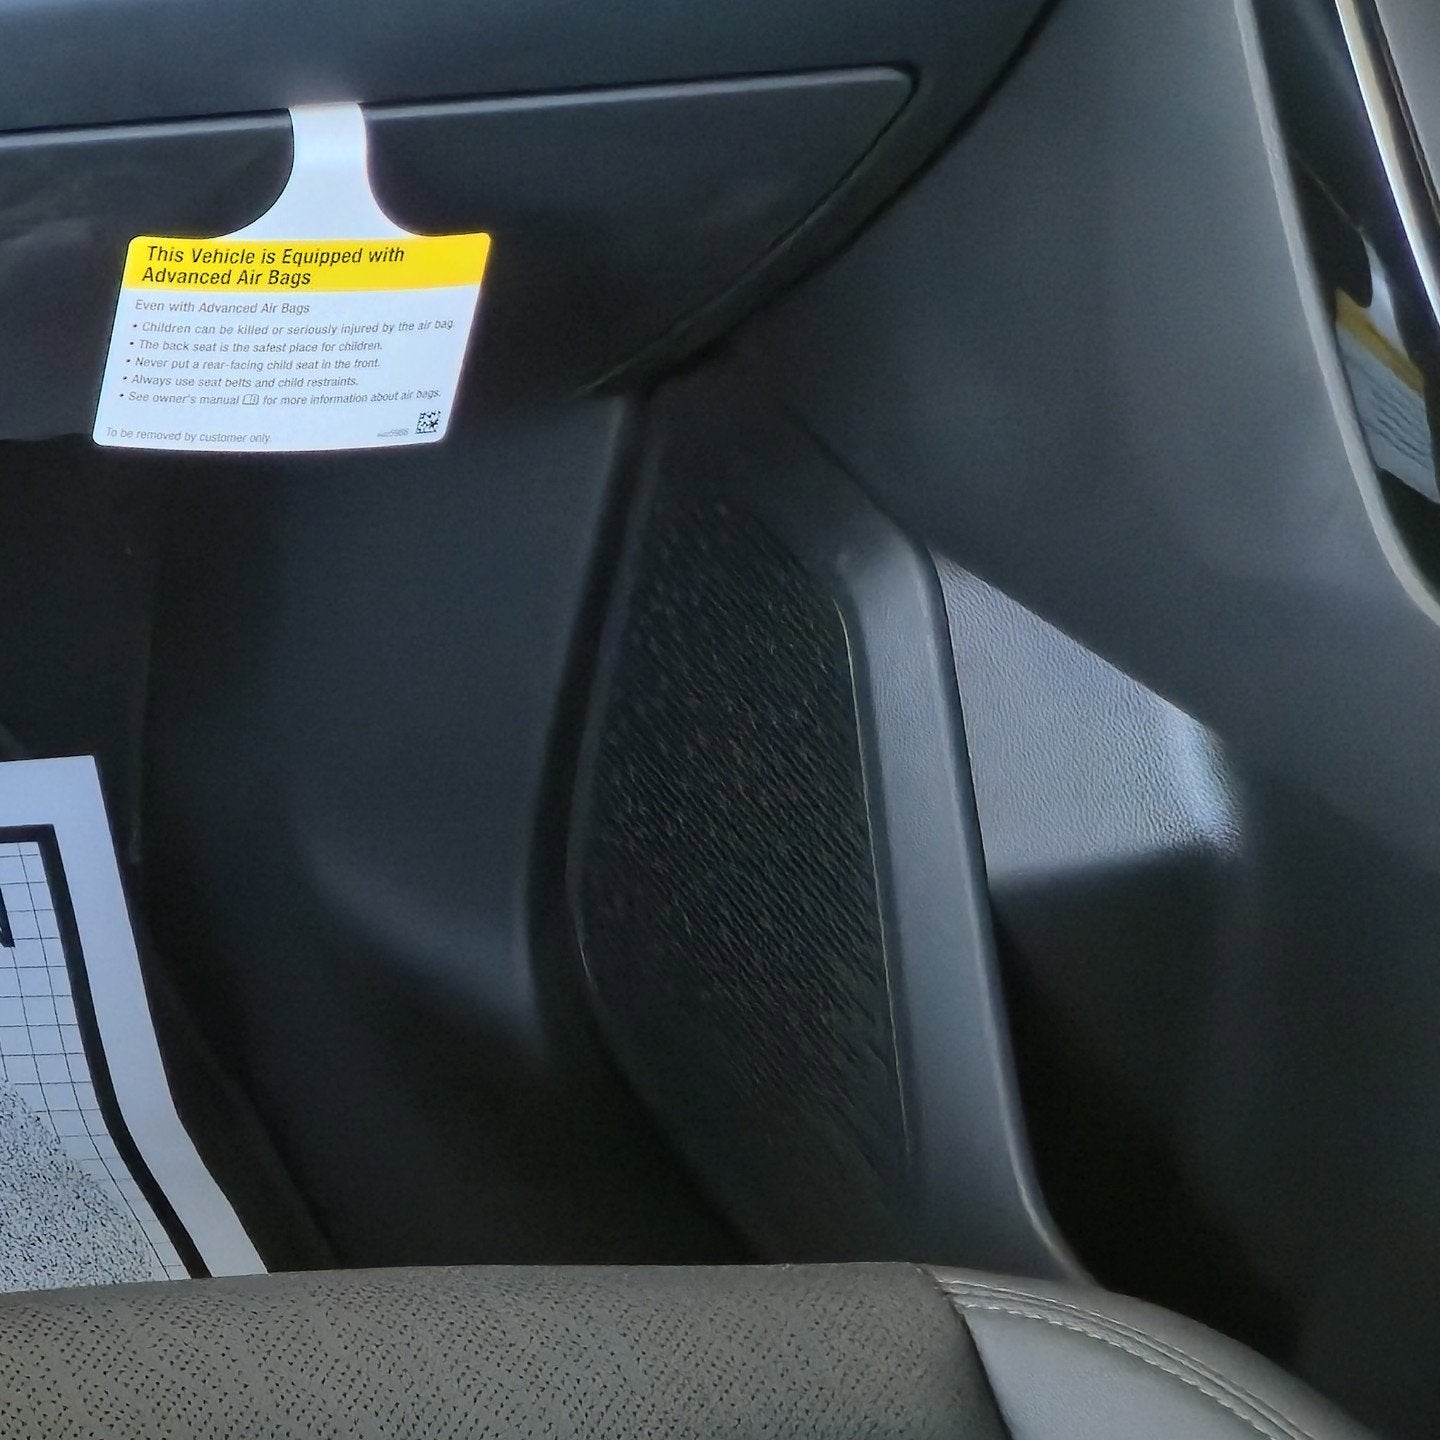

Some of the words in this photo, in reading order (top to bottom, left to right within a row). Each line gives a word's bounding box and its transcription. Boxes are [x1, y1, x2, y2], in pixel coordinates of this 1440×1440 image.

[147, 245, 184, 263] This
[191, 248, 256, 264] Vehicle
[261, 248, 276, 264] is
[282, 248, 363, 267] Equipped
[369, 247, 404, 263] with
[142, 266, 231, 285] Advanced
[236, 269, 262, 285] Air
[267, 269, 311, 288] Bags
[135, 299, 164, 311] Even
[169, 300, 195, 312] with
[198, 302, 258, 314] Advanced
[260, 302, 277, 314] Air
[281, 302, 311, 316] Bags
[142, 321, 191, 335] Children
[195, 325, 215, 335] can
[219, 323, 233, 335] be
[237, 323, 268, 335] killed
[272, 326, 284, 335] or
[287, 323, 337, 336] seriously
[341, 322, 379, 336] injured
[382, 322, 394, 333] by
[399, 320, 414, 332] the
[418, 320, 431, 330] air
[139, 339, 159, 350] The
[162, 340, 189, 351] back
[193, 342, 216, 352] seat
[219, 342, 229, 352] is
[233, 342, 249, 353] the
[253, 342, 286, 353] safest
[289, 343, 317, 354] place
[321, 342, 336, 352] for
[339, 341, 382, 352] children.
